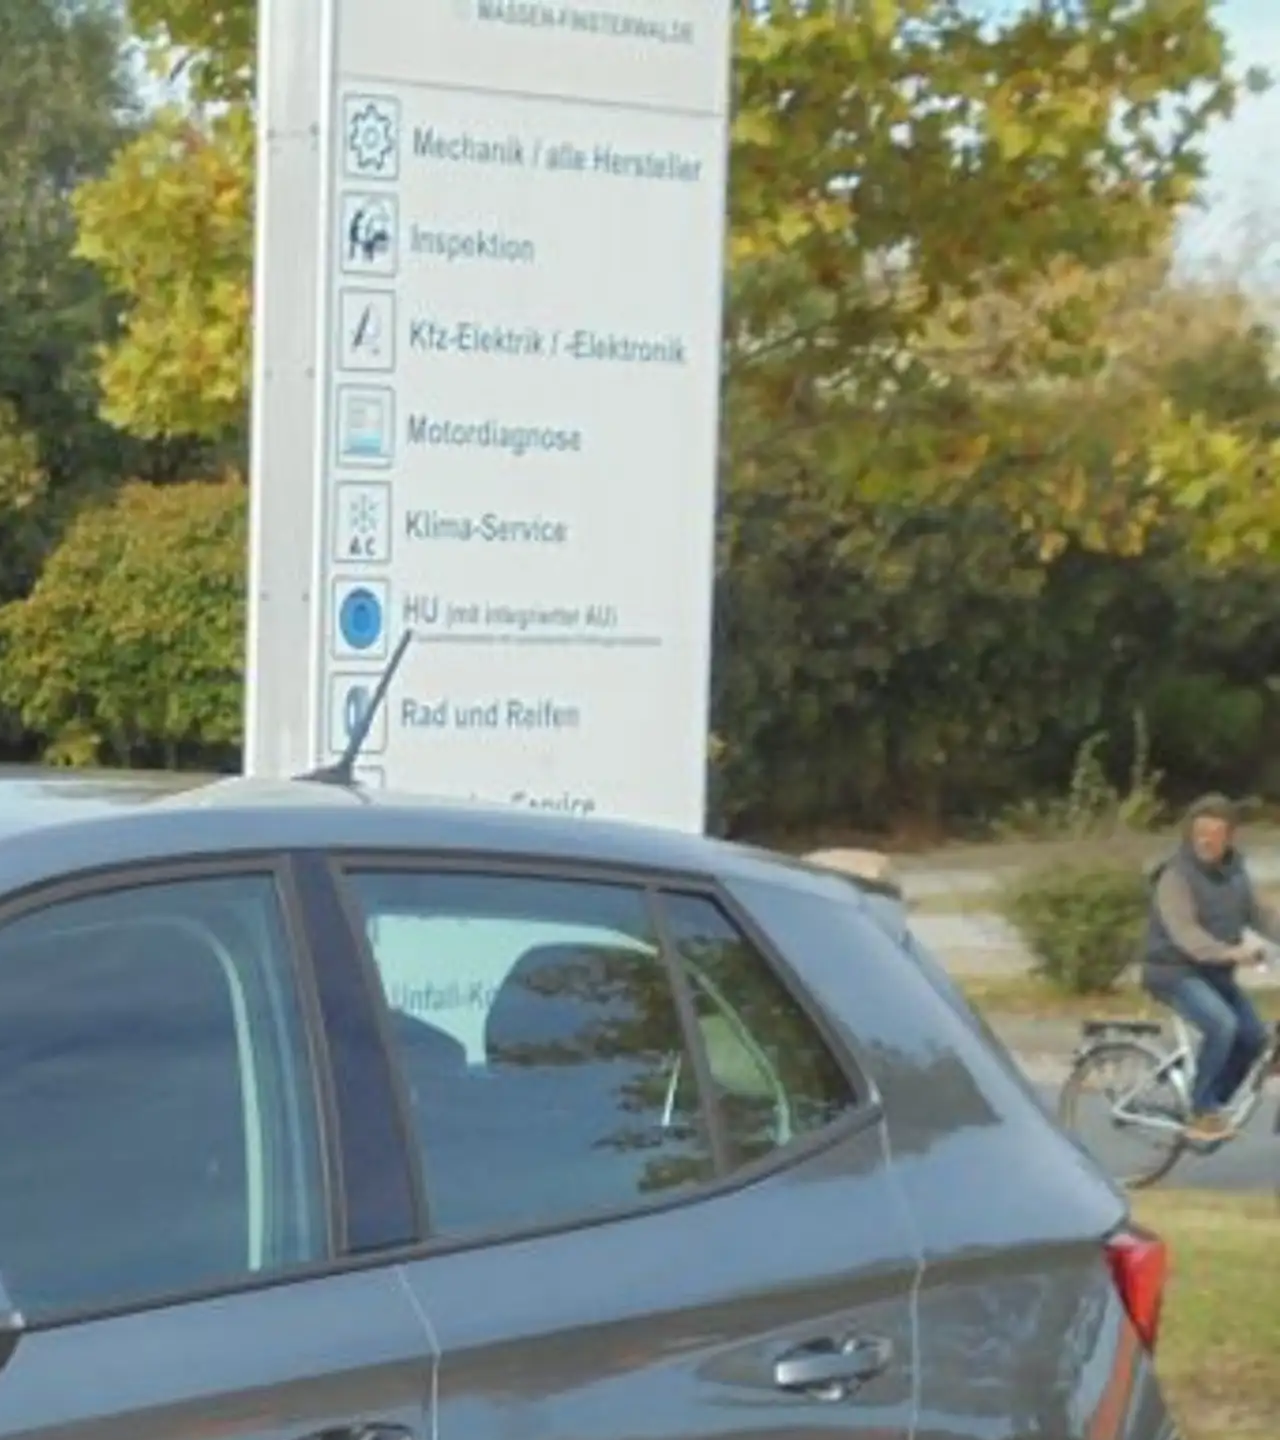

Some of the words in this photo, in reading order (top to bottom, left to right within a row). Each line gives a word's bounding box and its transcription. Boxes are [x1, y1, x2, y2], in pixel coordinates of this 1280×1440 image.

[413, 127, 523, 165] Mechanik
[546, 142, 588, 171] alle
[593, 145, 702, 181] Hersteller
[411, 225, 534, 262] Inspektion
[410, 320, 543, 354] Kfz-Elektrik
[563, 330, 686, 364] -Elektronik
[407, 413, 581, 456] Motordiagnose
[405, 511, 567, 543] Klima-Service
[403, 595, 438, 624] HU
[401, 698, 448, 728] Rad
[455, 701, 498, 729] und
[506, 699, 578, 729] Reifen
